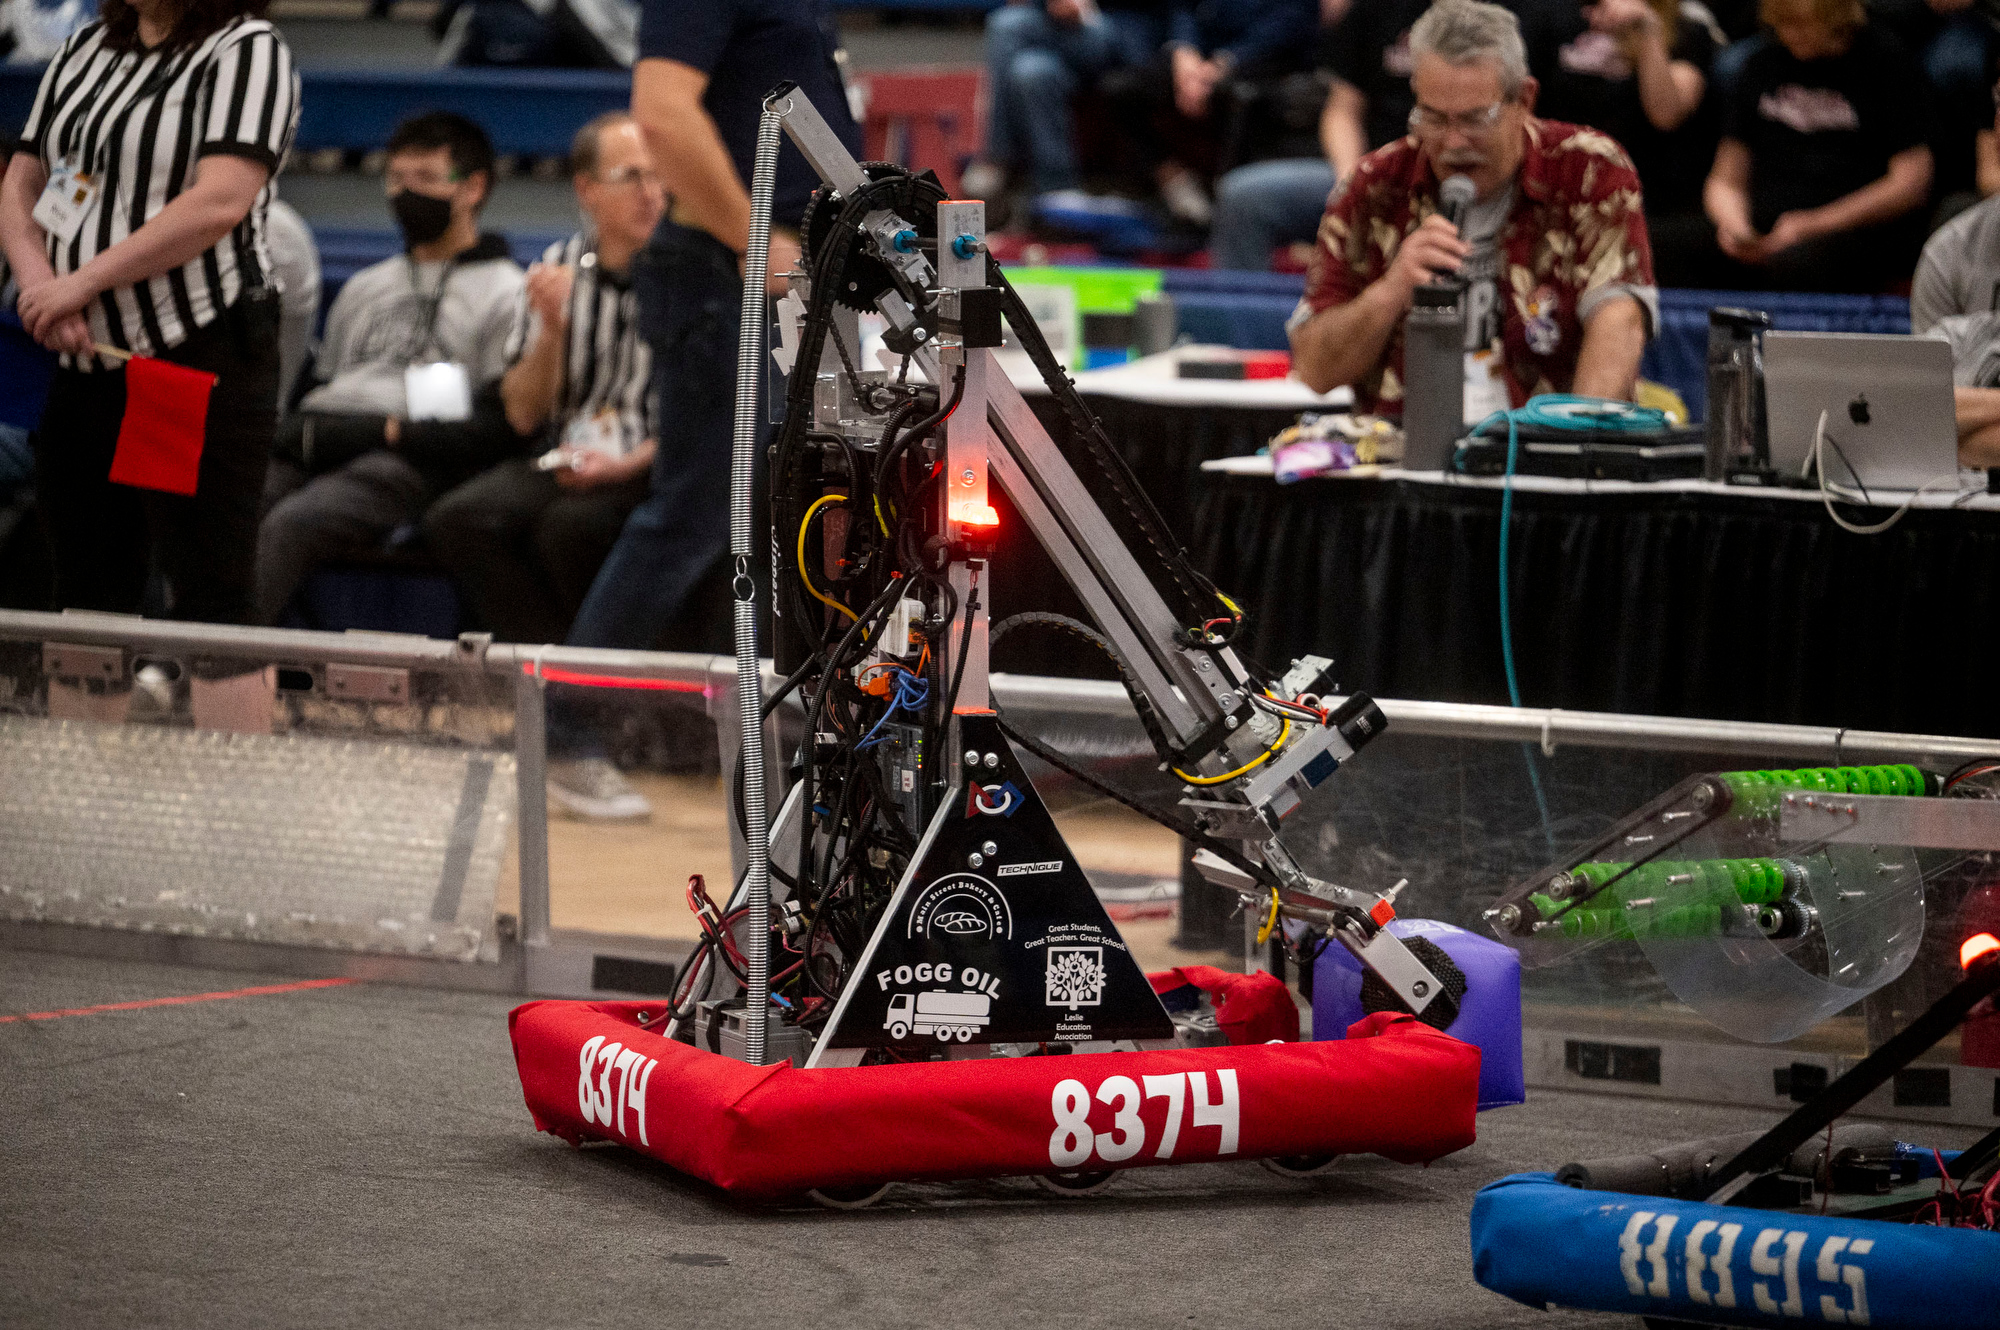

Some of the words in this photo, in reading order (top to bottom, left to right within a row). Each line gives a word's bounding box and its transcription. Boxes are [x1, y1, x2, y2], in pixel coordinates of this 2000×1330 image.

[999, 862, 1061, 875] TECHNIQUE
[916, 901, 932, 925] Main
[929, 883, 956, 901] Street
[958, 881, 989, 898] Bakery
[992, 904, 1003, 926] Cafe
[1048, 924, 1069, 933] Great
[1024, 937, 1046, 949] Great
[1079, 933, 1100, 943] Great
[876, 962, 953, 992] FOGG
[961, 967, 1001, 1000] OIL
[1064, 1013, 1084, 1022] Leslie
[1056, 1023, 1092, 1031] Education
[1054, 1032, 1093, 1041] Association
[578, 1035, 659, 1147] 8374
[1048, 1068, 1241, 1168] 8374
[1617, 1210, 1875, 1327] 8895
